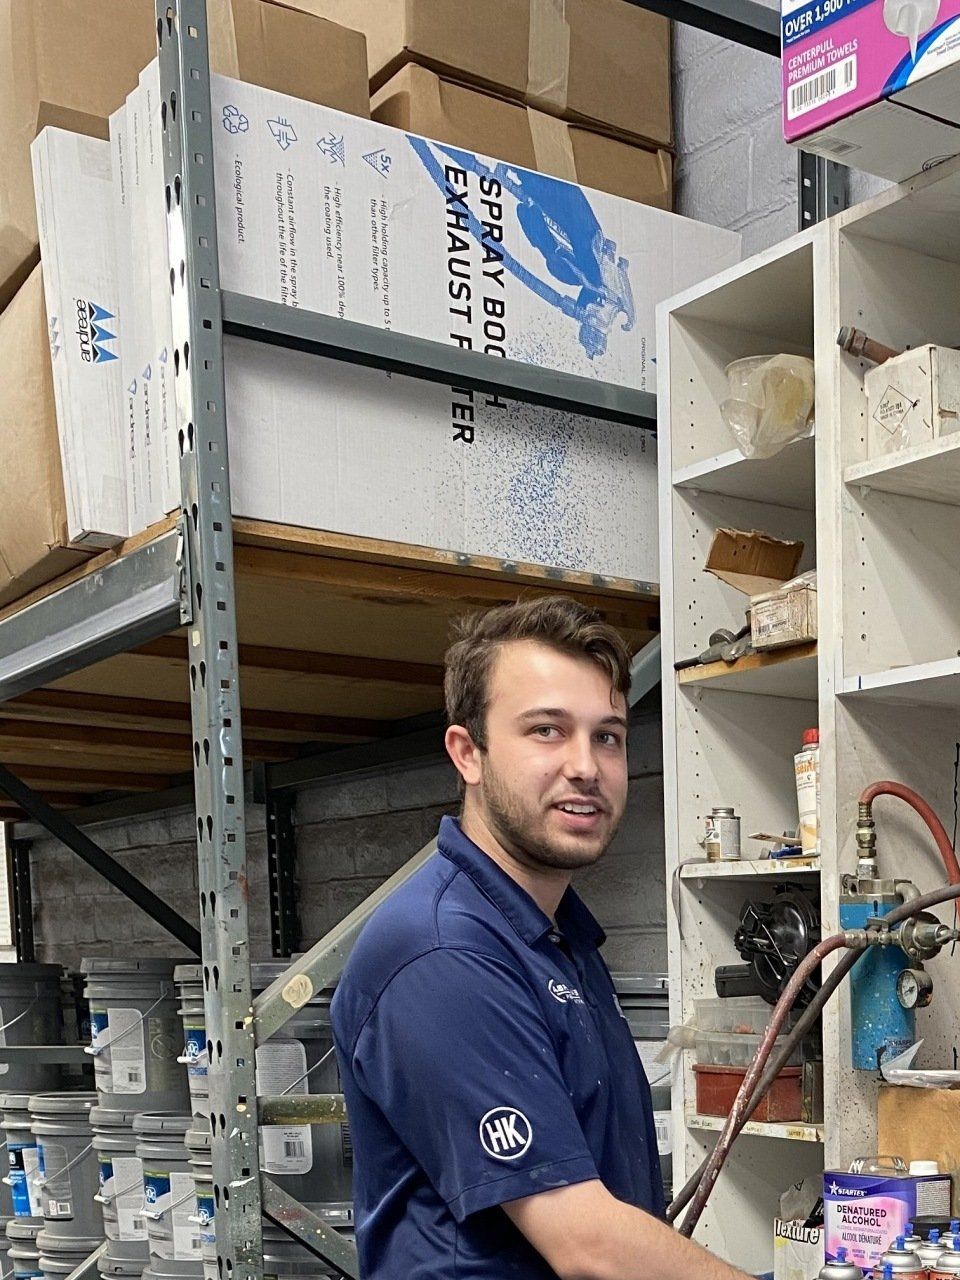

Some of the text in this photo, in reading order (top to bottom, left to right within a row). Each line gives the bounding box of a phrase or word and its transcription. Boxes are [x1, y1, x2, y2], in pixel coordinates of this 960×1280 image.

[785, 10, 812, 36] OVER
[815, 0, 843, 21] 1,900
[788, 38, 834, 70] CENTERPULL
[788, 38, 858, 84] PREMIUM TOWELS
[234, 159, 244, 205] Ecological
[286, 174, 294, 213] Constant
[275, 172, 284, 223] throughout
[332, 187, 341, 210] High
[378, 200, 388, 221] High
[288, 216, 296, 246] airflow
[335, 212, 345, 250] efficiency
[379, 222, 389, 260] holding
[444, 164, 473, 324] EXHAUST
[479, 174, 506, 288] SPRAY
[278, 242, 286, 256] life
[280, 258, 287, 269] of
[290, 248, 296, 256] in
[372, 244, 380, 267] filter
[290, 274, 298, 299] spray
[381, 261, 390, 293] capacity
[382, 294, 390, 306] up
[384, 309, 390, 320] to
[76, 300, 92, 363] andreae
[485, 1114, 526, 1152] HK
[837, 1205, 887, 1218] DENATURED
[842, 1215, 881, 1227] ALCOHOL
[776, 1218, 820, 1244] Texture
[842, 1232, 858, 1241] ALCOOL
